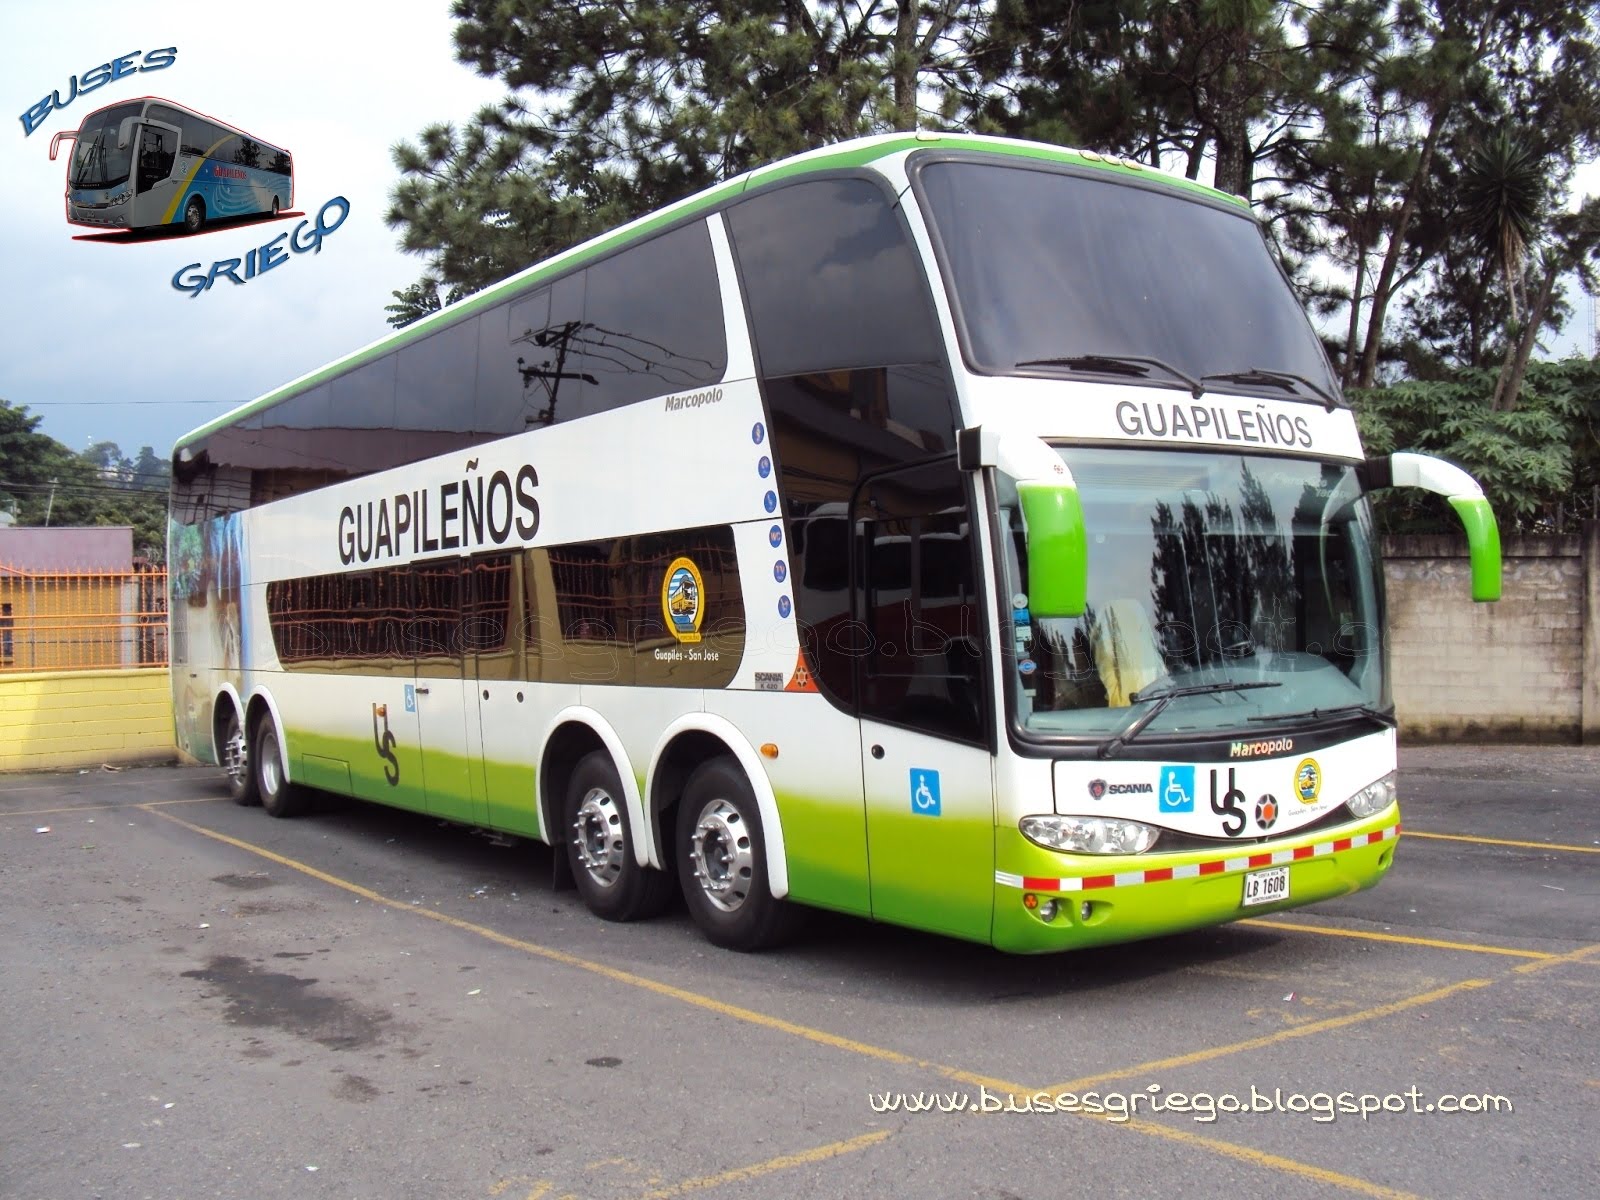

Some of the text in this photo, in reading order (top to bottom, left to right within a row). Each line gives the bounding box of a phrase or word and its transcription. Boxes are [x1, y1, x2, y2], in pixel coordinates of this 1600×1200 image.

[665, 387, 723, 412] Marcopolo
[1115, 400, 1313, 449] GUAPILEÑOS
[338, 457, 540, 566] GUAPILEÑOS
[770, 532, 781, 541] WC
[654, 648, 683, 662] Guapiles
[689, 648, 702, 660] San
[703, 648, 719, 661] Jose
[755, 672, 783, 682] SCANIA
[1229, 738, 1293, 757] Marcopolo
[1108, 783, 1153, 794] SCANIA
[1246, 875, 1285, 898] LB 1608
